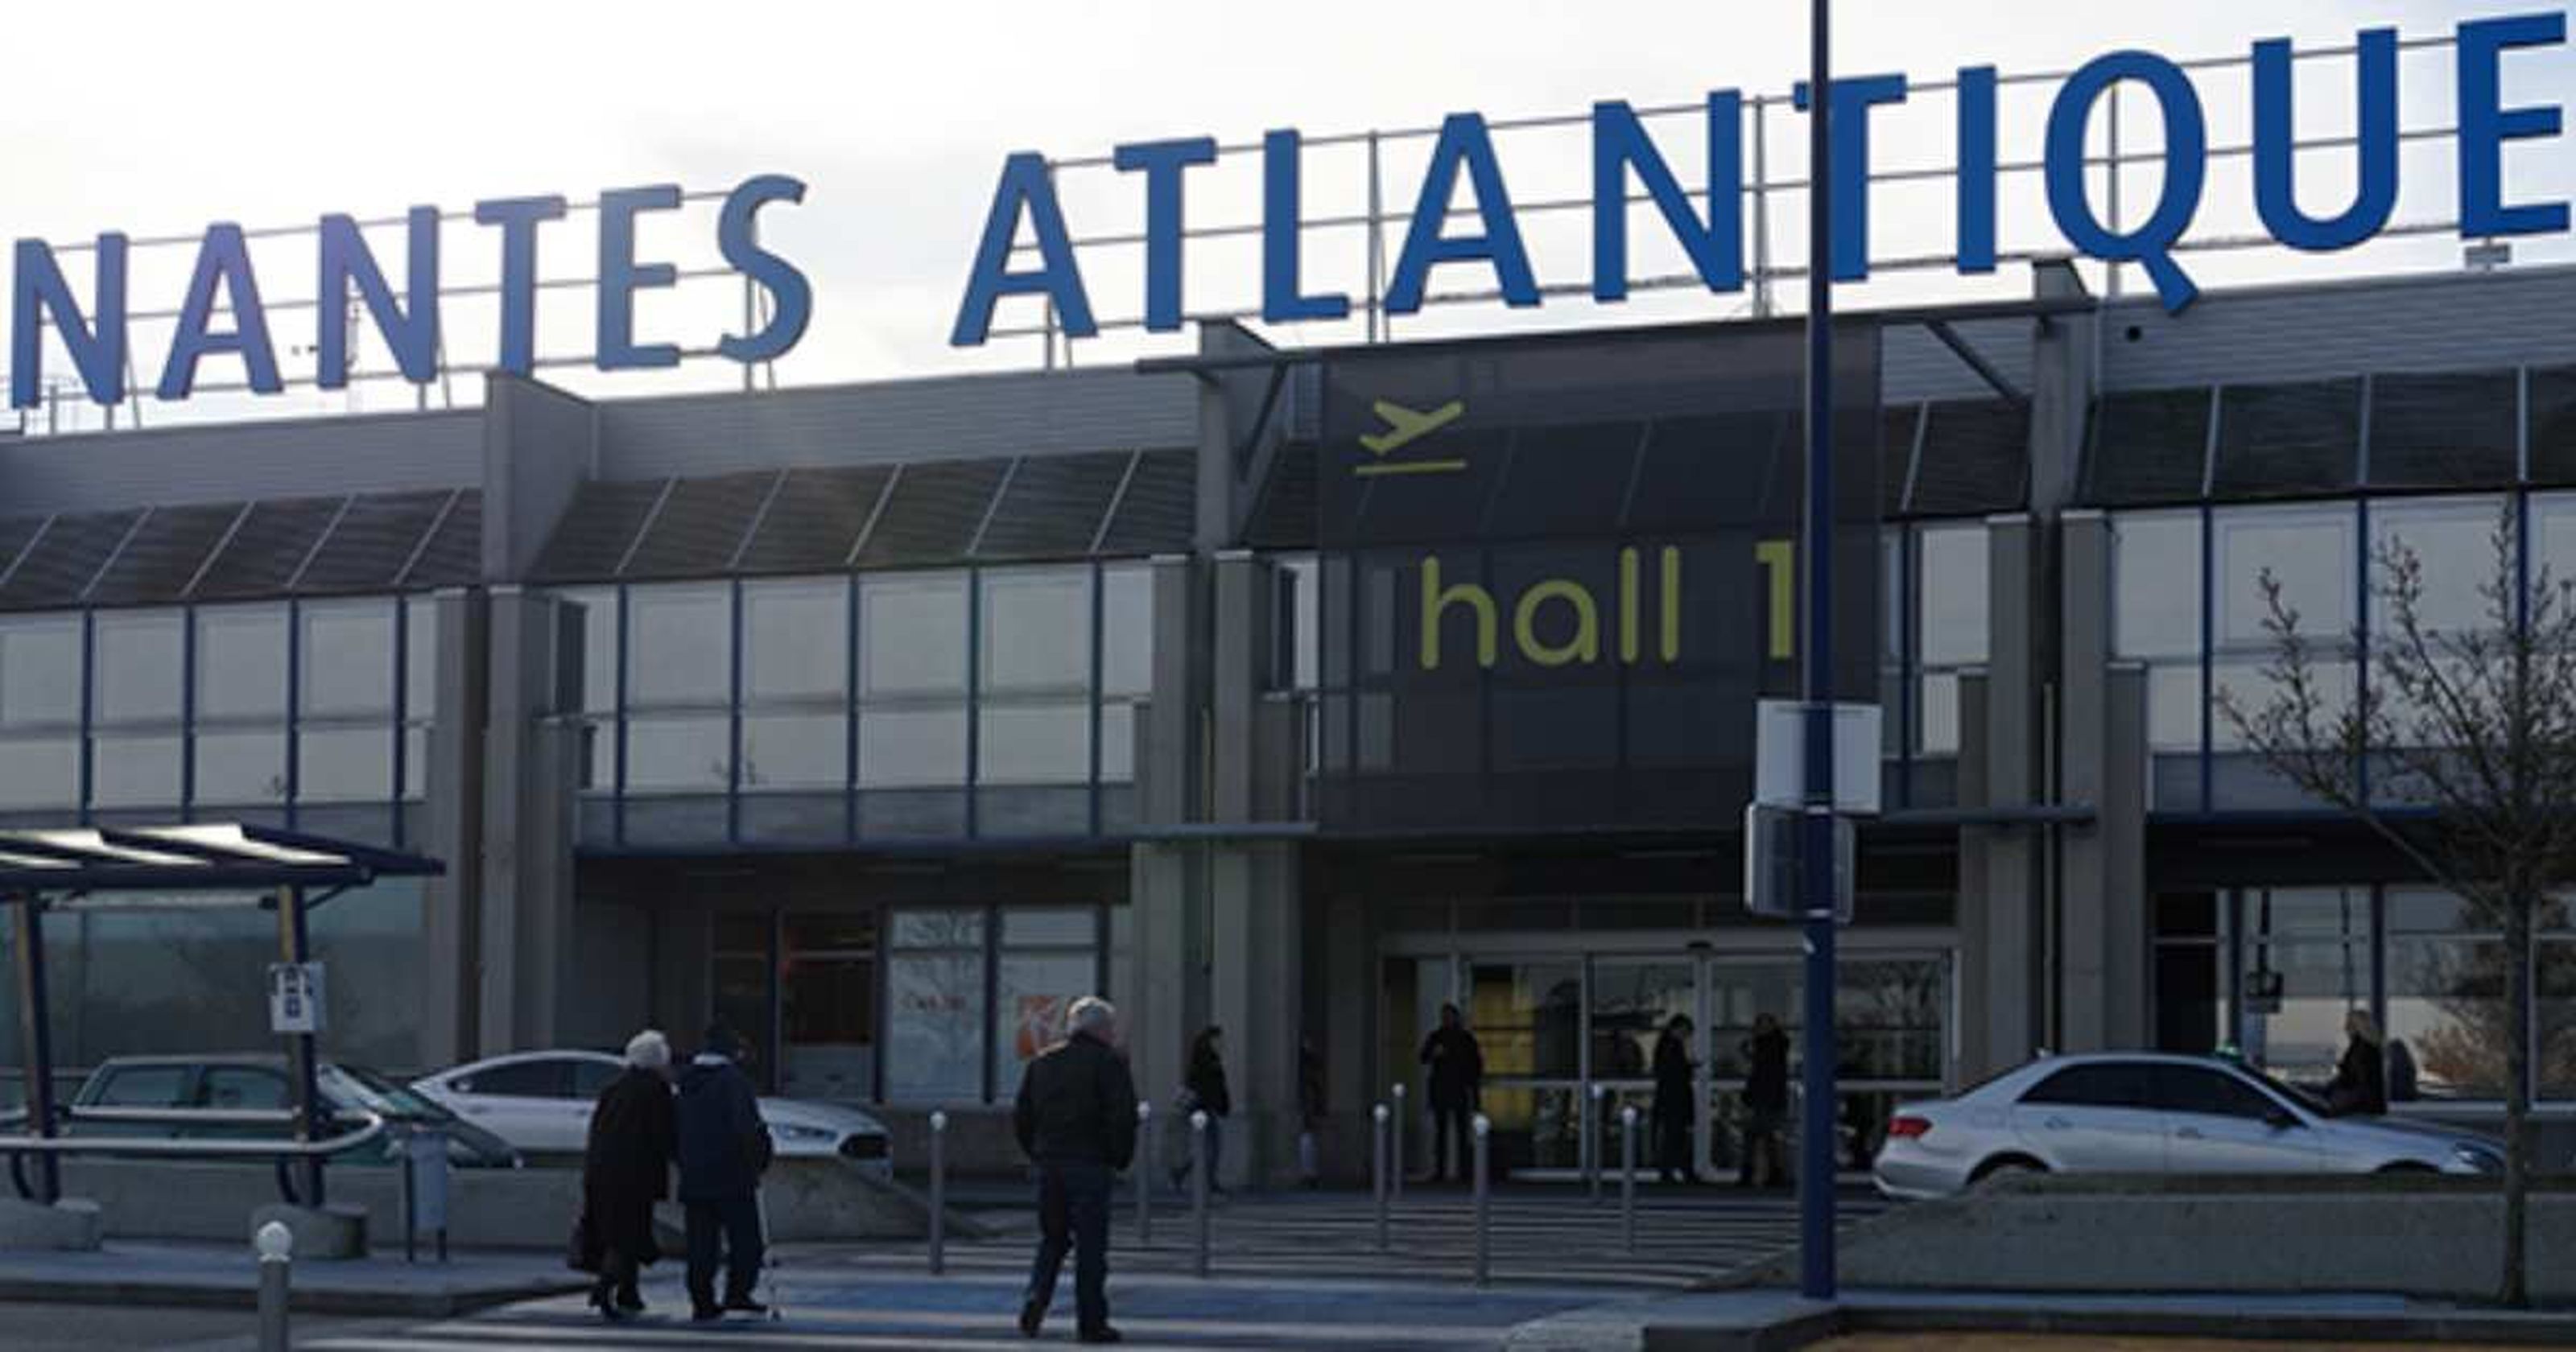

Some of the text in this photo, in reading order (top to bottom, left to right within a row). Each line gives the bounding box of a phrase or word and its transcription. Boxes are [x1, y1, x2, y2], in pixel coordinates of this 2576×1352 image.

[11, 11, 2571, 409] NANTES ATLANTIQUE
[1421, 540, 1794, 670] hall 1
